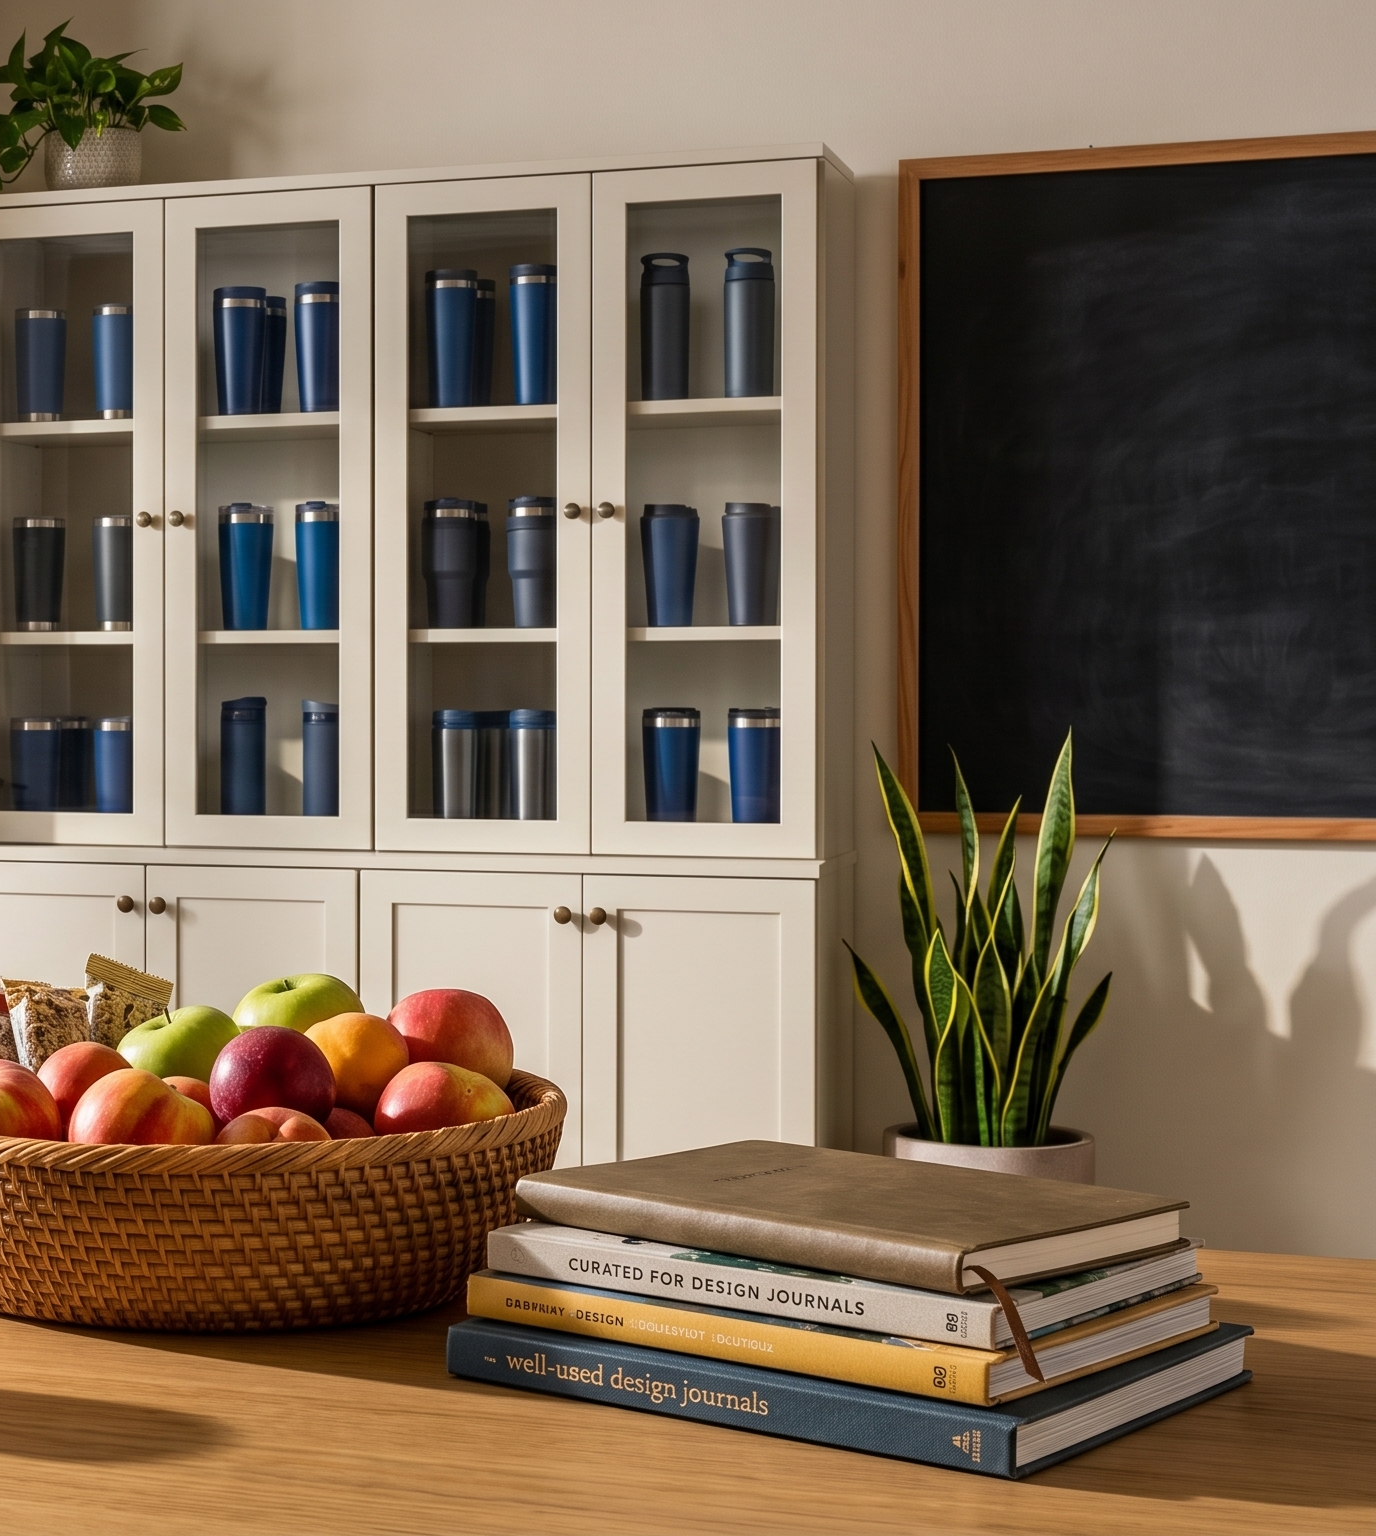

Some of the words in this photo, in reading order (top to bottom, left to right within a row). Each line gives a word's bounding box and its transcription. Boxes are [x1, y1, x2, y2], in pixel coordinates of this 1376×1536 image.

[568, 1257, 644, 1281] CURATED
[650, 1269, 684, 1288] FOR
[692, 1276, 760, 1300] DESIGN
[766, 1288, 865, 1316] JOURNALS
[576, 1309, 624, 1327] DESIGN
[506, 1353, 604, 1386] well-used
[610, 1367, 677, 1404] design
[680, 1380, 769, 1416] journals
